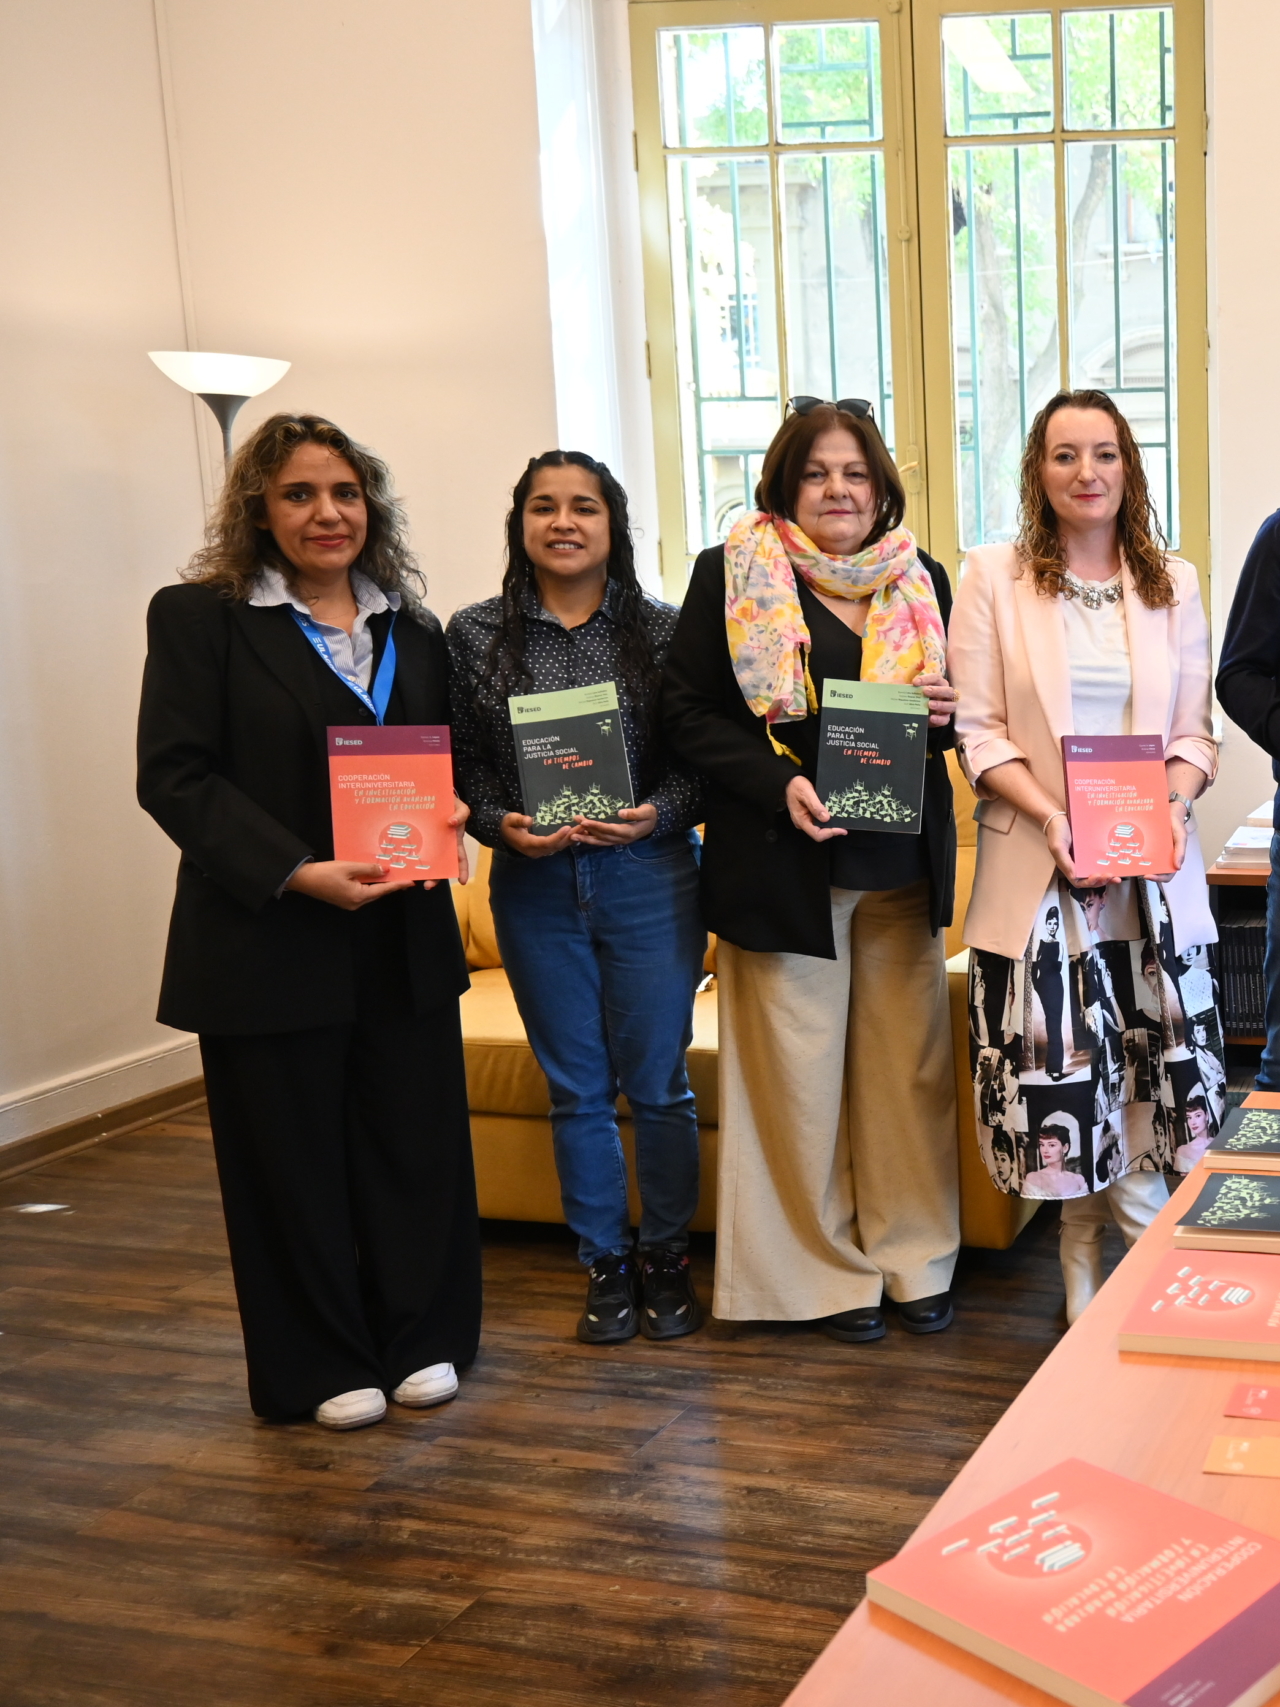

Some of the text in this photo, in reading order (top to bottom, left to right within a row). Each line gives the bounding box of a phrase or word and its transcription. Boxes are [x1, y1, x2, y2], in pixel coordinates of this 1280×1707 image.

[828, 725, 864, 734] EDUCACIÓN
[522, 736, 560, 746] EDUCACIÓN
[524, 747, 578, 759] JUSTICIA SOCIAL
[854, 749, 880, 757] TIEMPOS
[554, 755, 580, 763] TIEMPOS
[869, 758, 891, 766] CAMBIO
[571, 760, 593, 768] CAMBIO
[338, 773, 390, 781] COOPERACIÓN
[339, 781, 415, 789] INTERUNIVERSITARIA
[362, 795, 401, 804] FORMACIÓN
[1093, 798, 1124, 806] FORMACIÓN
[1177, 1542, 1262, 1602] COOPERACIÓN
[1120, 1535, 1246, 1623] INTERUNIVERSITARIA
